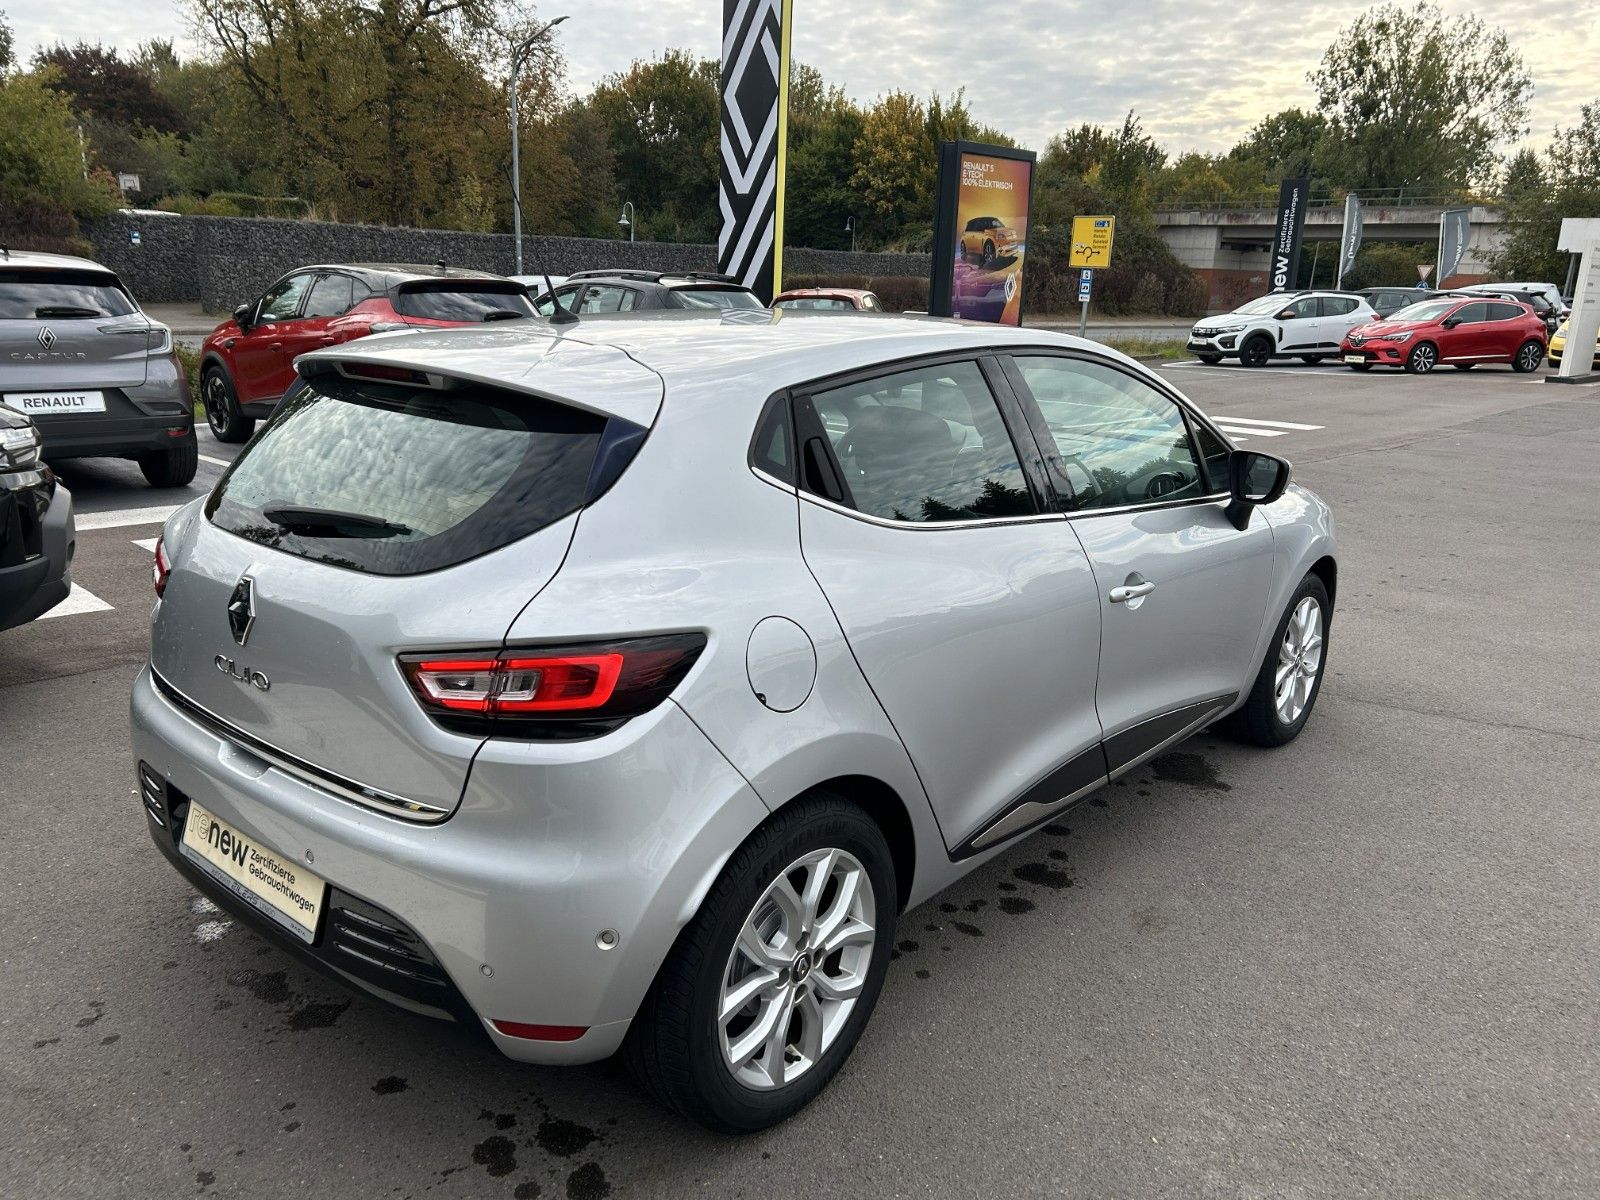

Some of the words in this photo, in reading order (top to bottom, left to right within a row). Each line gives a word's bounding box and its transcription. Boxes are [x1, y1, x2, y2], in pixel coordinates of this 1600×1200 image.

[962, 178, 979, 187] 100%
[978, 179, 1013, 190] ELEKTRISCH
[963, 161, 990, 172] RENAULT
[990, 164, 995, 173] 5
[1279, 209, 1290, 253] Zertifizierte
[1285, 188, 1299, 254] Gebrauchtwagen
[10, 352, 88, 360] CAPTUR
[22, 396, 86, 409] RENAULT
[214, 654, 271, 692] CLIO
[188, 807, 250, 868] renew
[250, 848, 296, 885] Zertifizierte
[248, 863, 316, 914] Gebrauchtwagen
